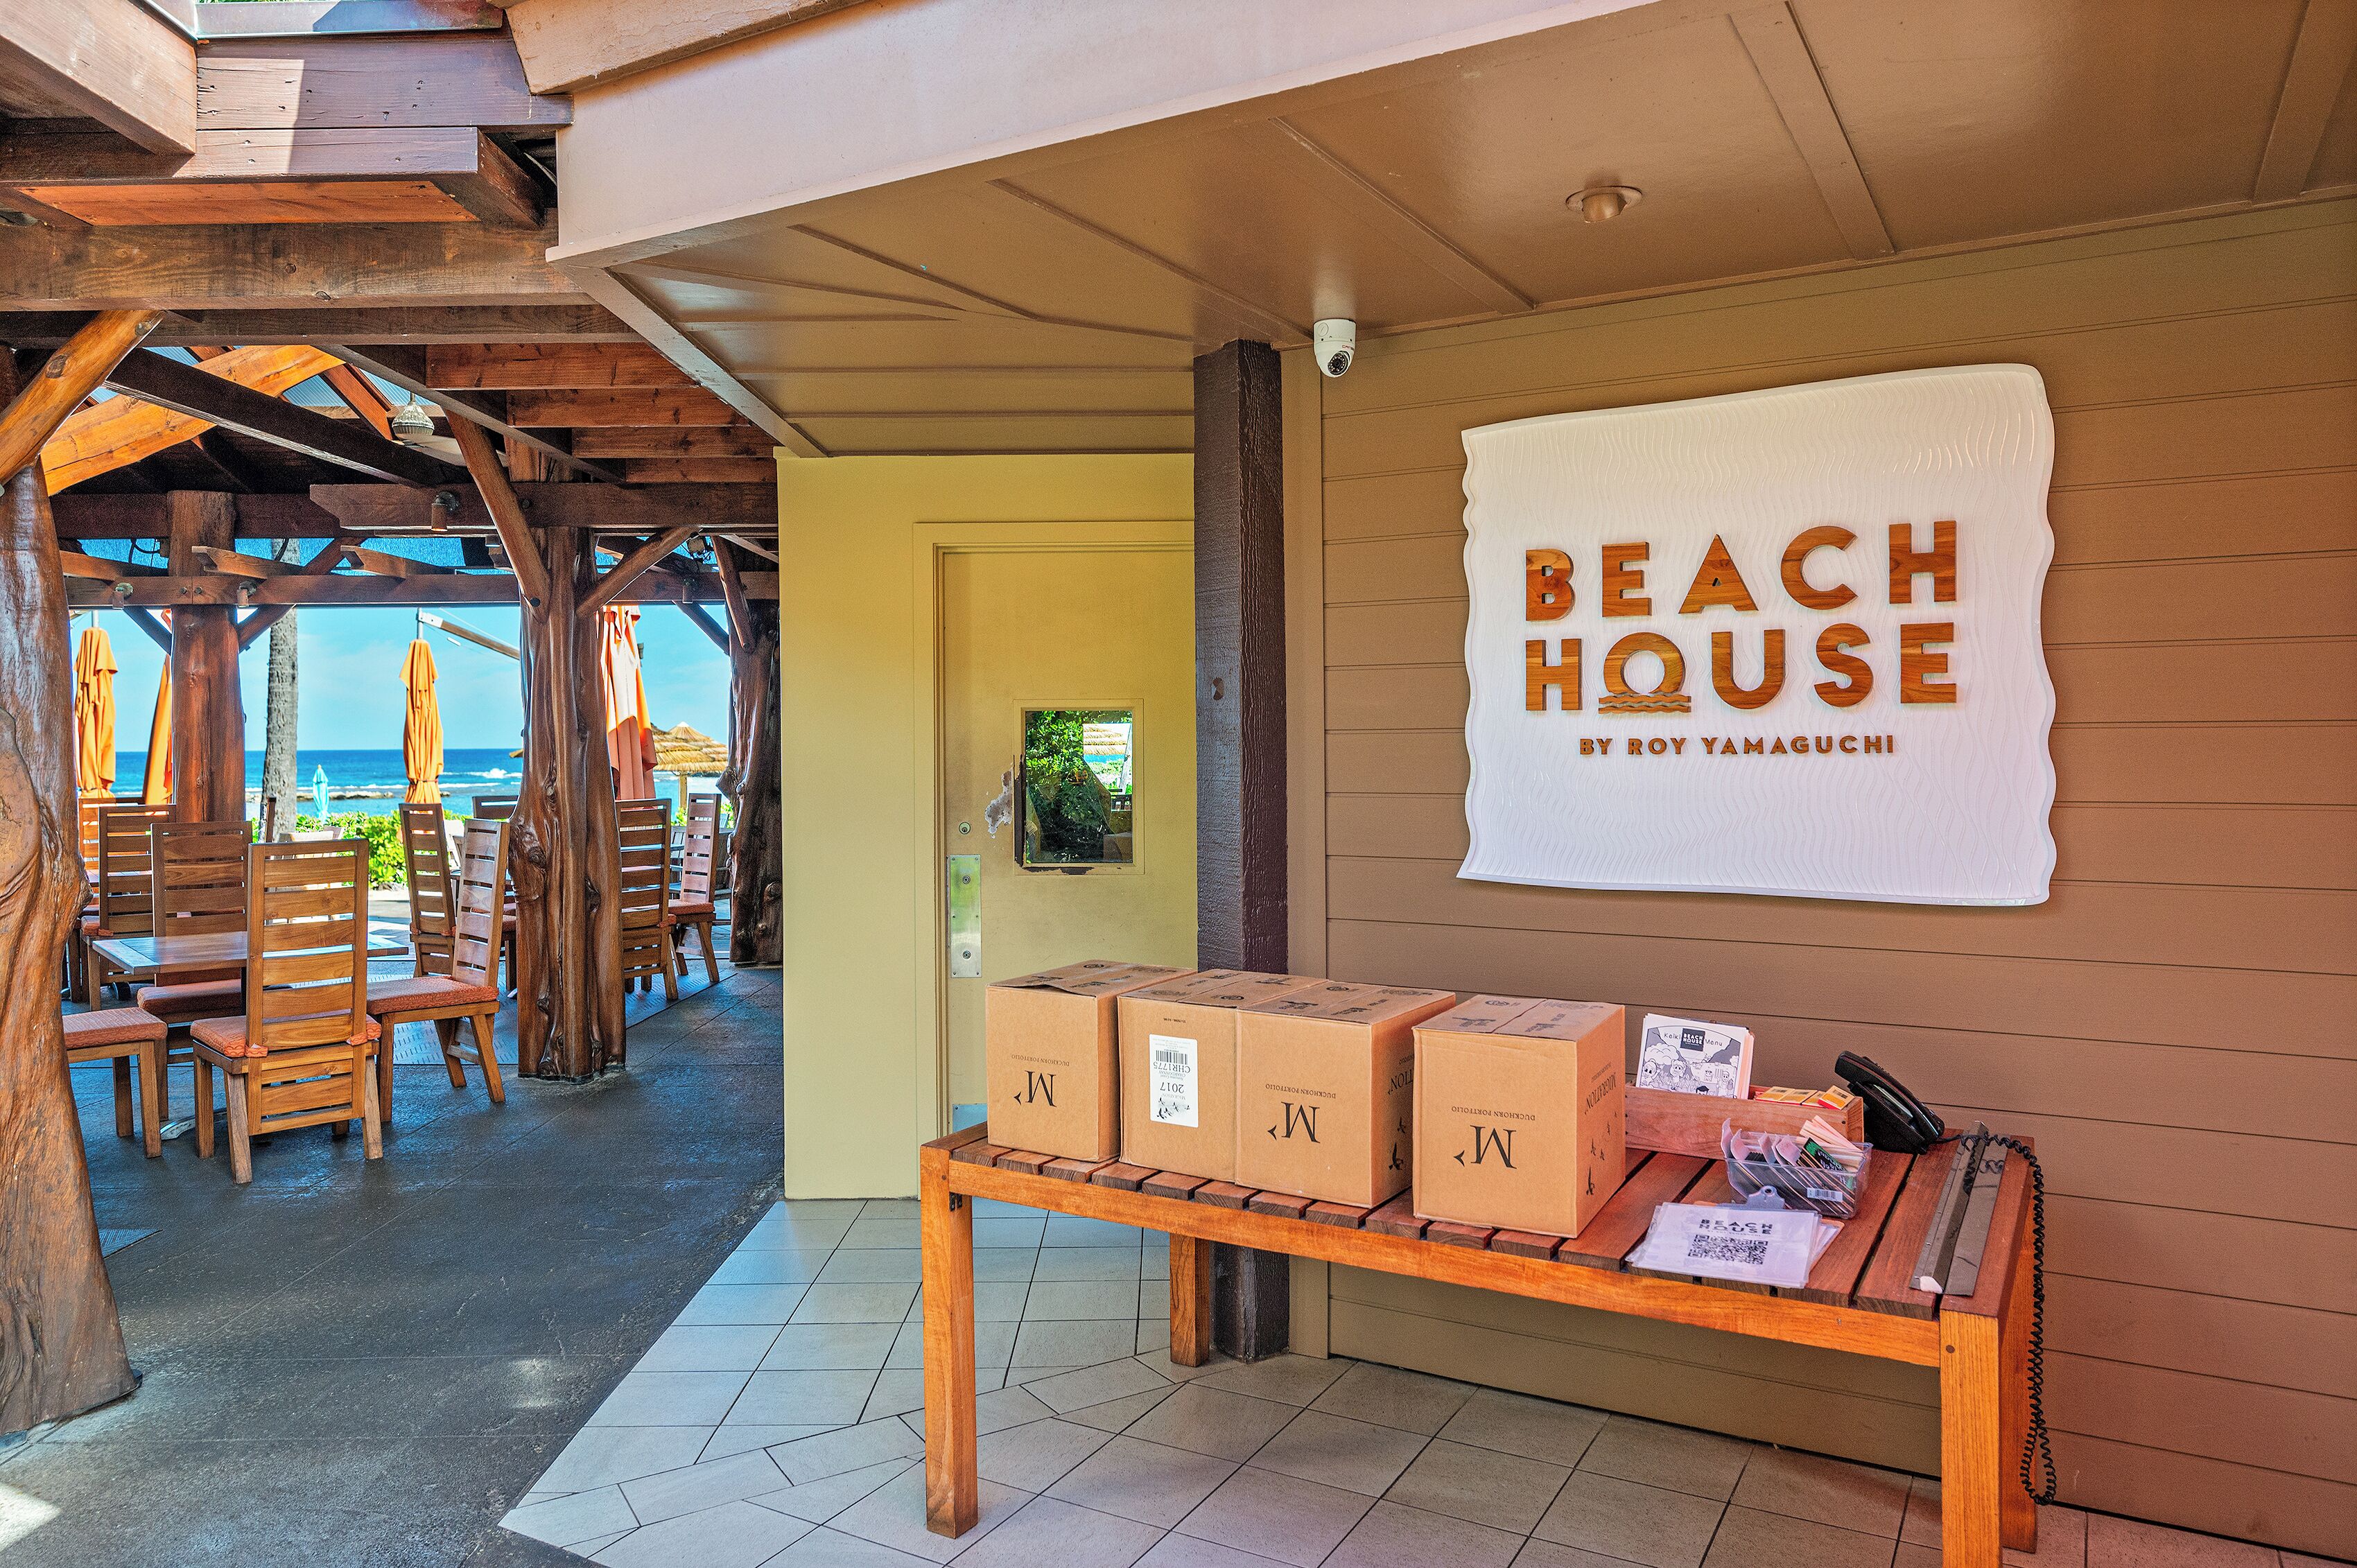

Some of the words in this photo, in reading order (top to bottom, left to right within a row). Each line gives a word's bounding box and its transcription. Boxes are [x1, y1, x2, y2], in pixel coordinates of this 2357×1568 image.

[1525, 520, 1958, 621] BEACH
[1525, 622, 1958, 715] HOUSE
[1578, 738, 1612, 756] BY
[1627, 737, 1685, 756] ROY
[1701, 735, 1895, 755] YAMAGUCHI
[1041, 1059, 1070, 1067] DUCKHORN
[1154, 1061, 1191, 1073] CHR1775
[1160, 1082, 1184, 1094] 2017
[1265, 1083, 1299, 1094] PORTFOLIO
[1301, 1089, 1337, 1099] DUCKHORN
[1451, 1106, 1492, 1116] PORTFOLIO
[1493, 1110, 1536, 1121] DUCKHORN
[1698, 1223, 1772, 1235] HOUSE
[1701, 1219, 1773, 1229] BEACH
